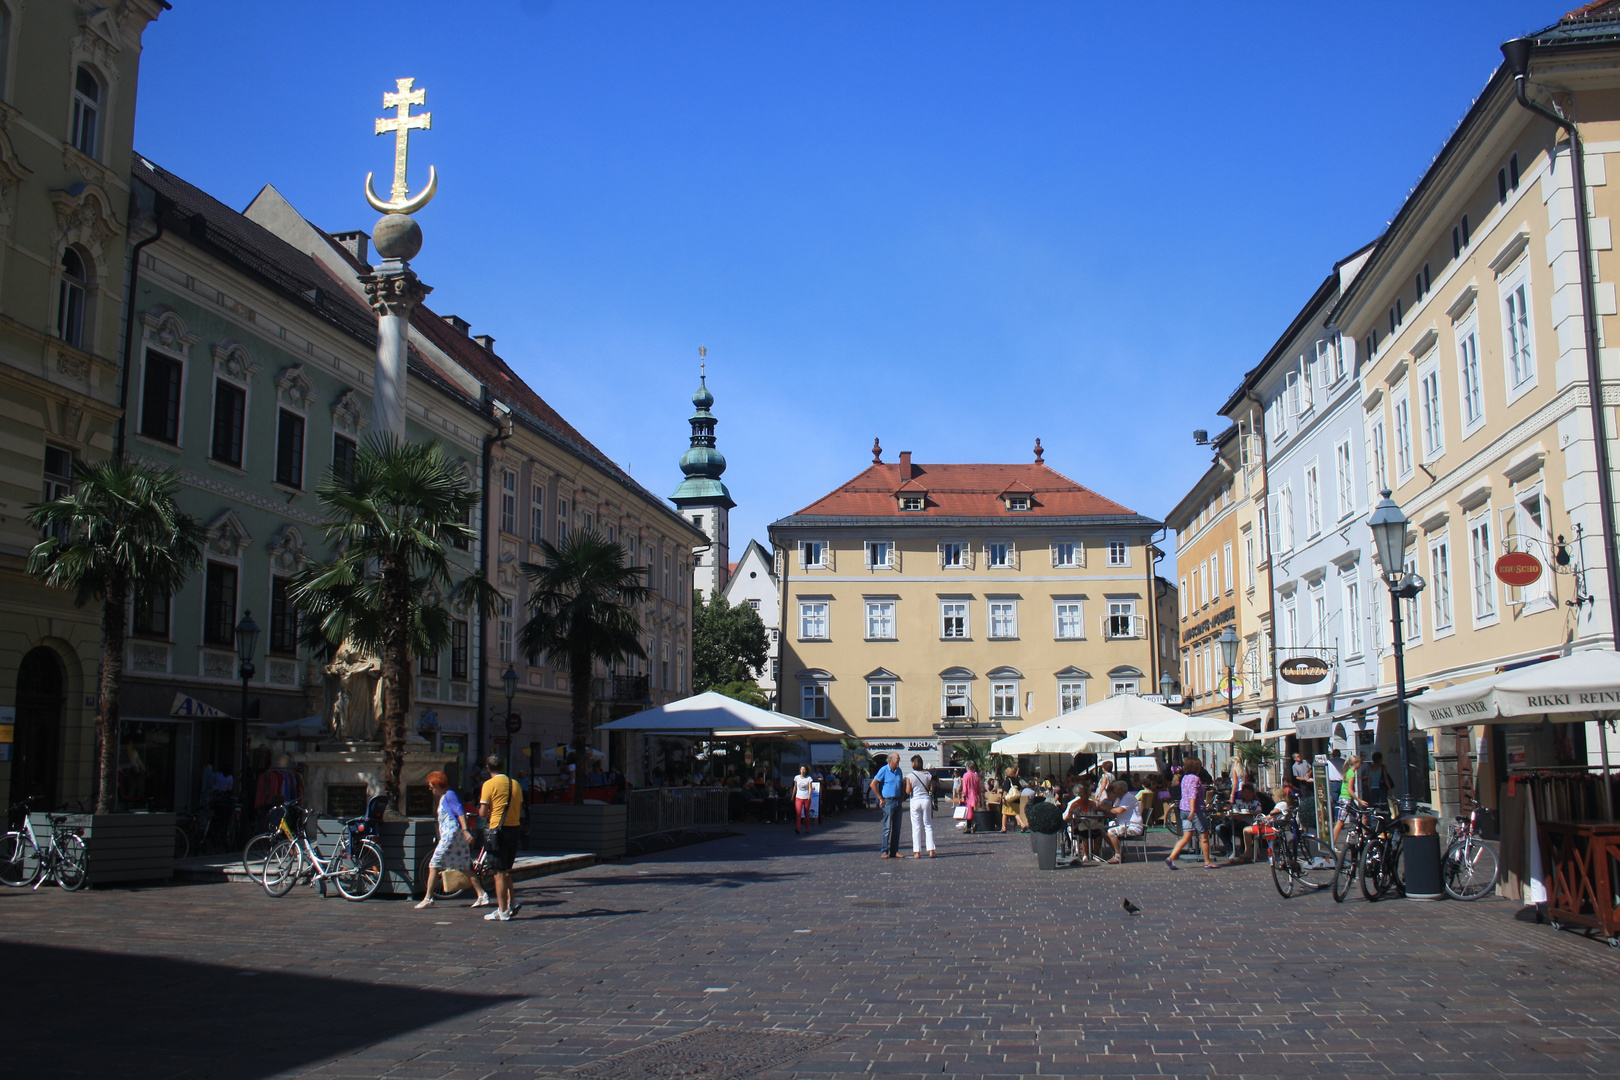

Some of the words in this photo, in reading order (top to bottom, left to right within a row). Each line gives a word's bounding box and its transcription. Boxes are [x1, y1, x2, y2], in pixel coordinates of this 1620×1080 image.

[1499, 564, 1539, 574] EDUSCHO
[1284, 666, 1295, 676] LA
[1296, 666, 1326, 676] PIAZZA
[172, 697, 218, 716] ANNA
[1527, 693, 1570, 707] RIKKI
[1429, 707, 1453, 720] RIKKI
[1454, 700, 1488, 716] REINER
